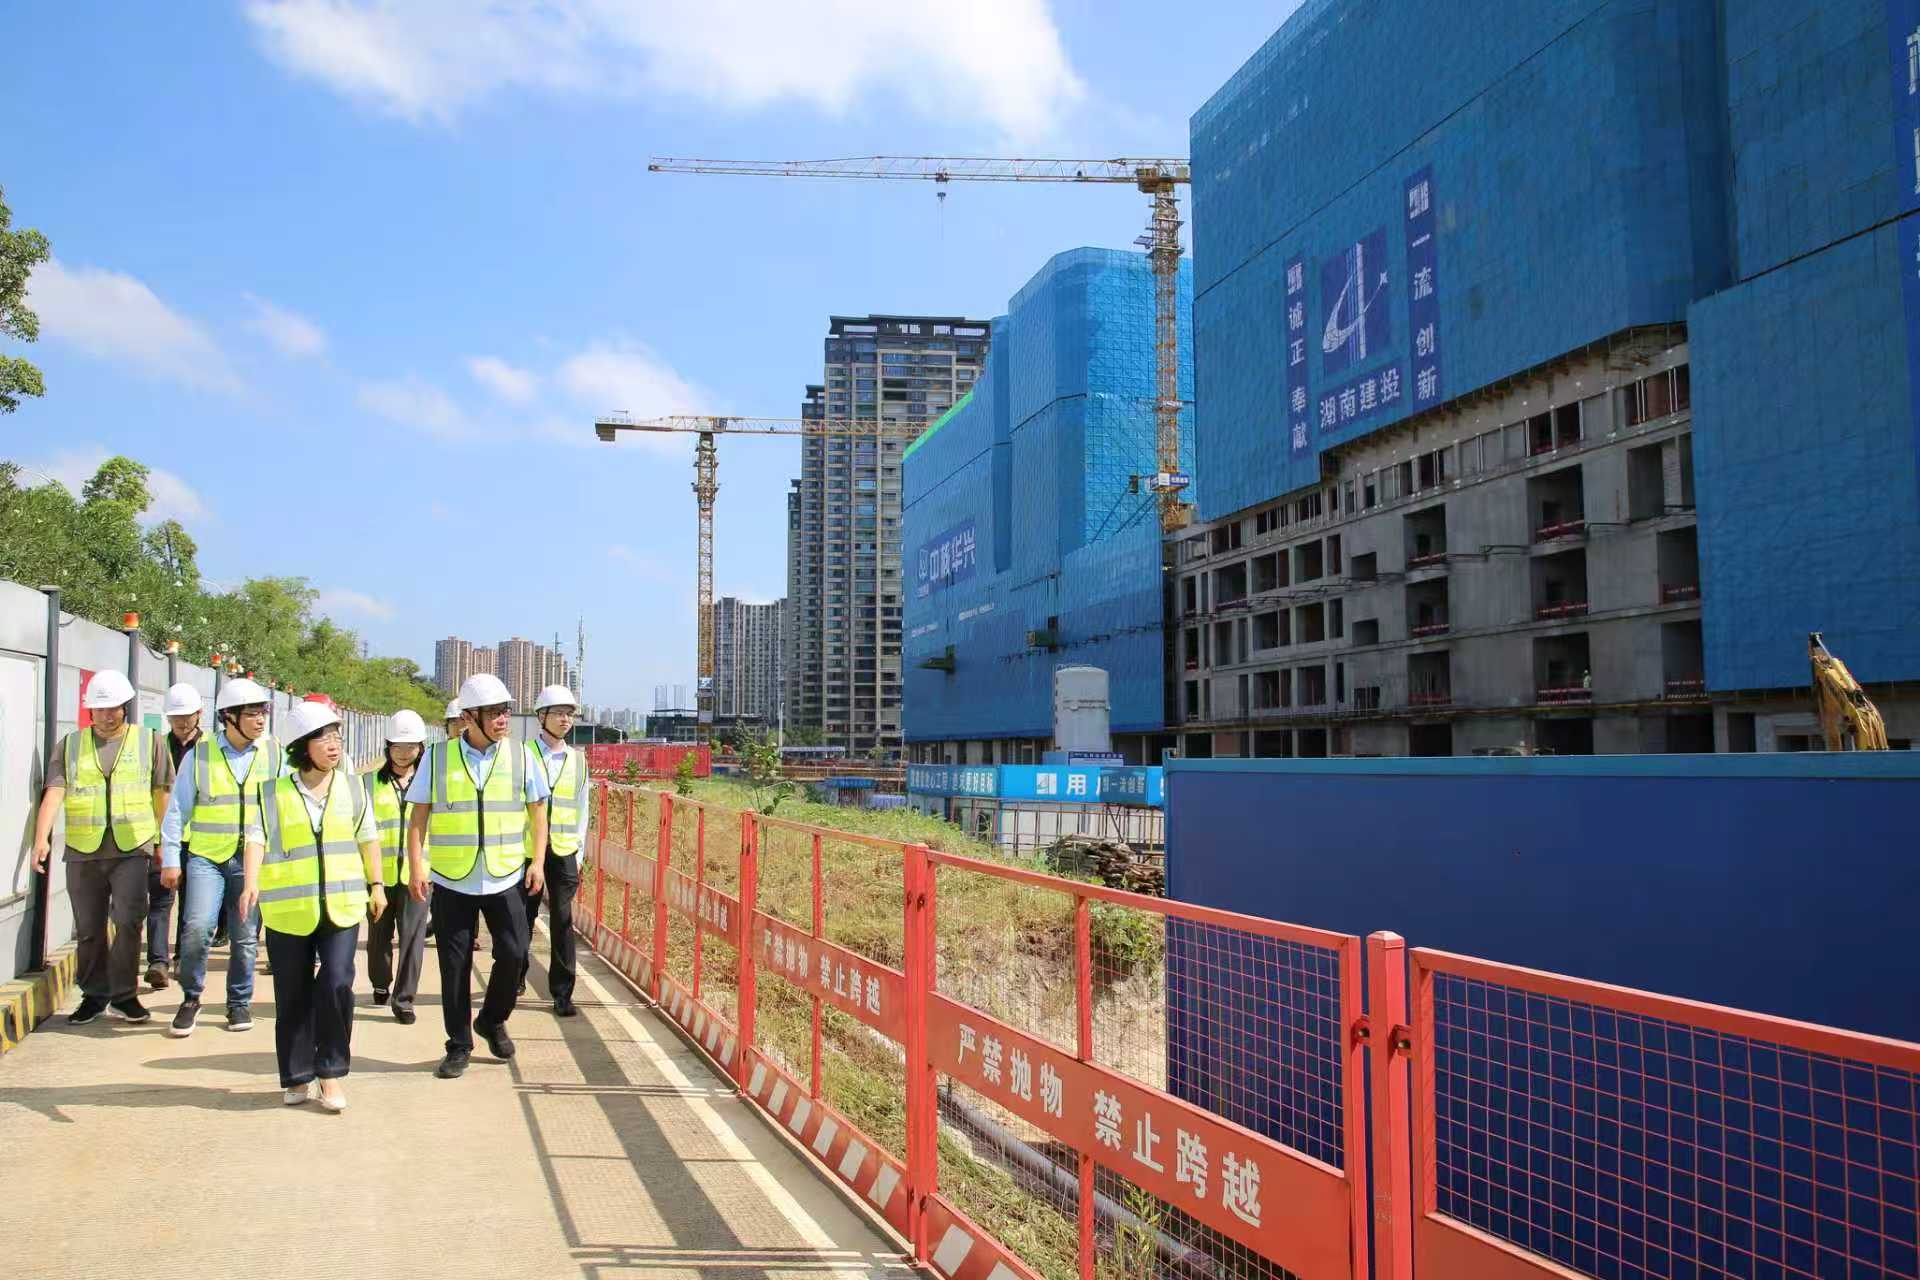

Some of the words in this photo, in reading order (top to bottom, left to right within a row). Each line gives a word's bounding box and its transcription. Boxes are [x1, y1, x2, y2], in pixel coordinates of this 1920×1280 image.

[1409, 180, 1437, 400] 一流创新
[1320, 368, 1400, 428] 湖南建投
[764, 928, 808, 978] 严禁抛物
[820, 953, 880, 1016] 禁止跨越
[957, 1023, 1063, 1118] 严禁抛物
[1094, 1089, 1262, 1229] 禁止跨越
